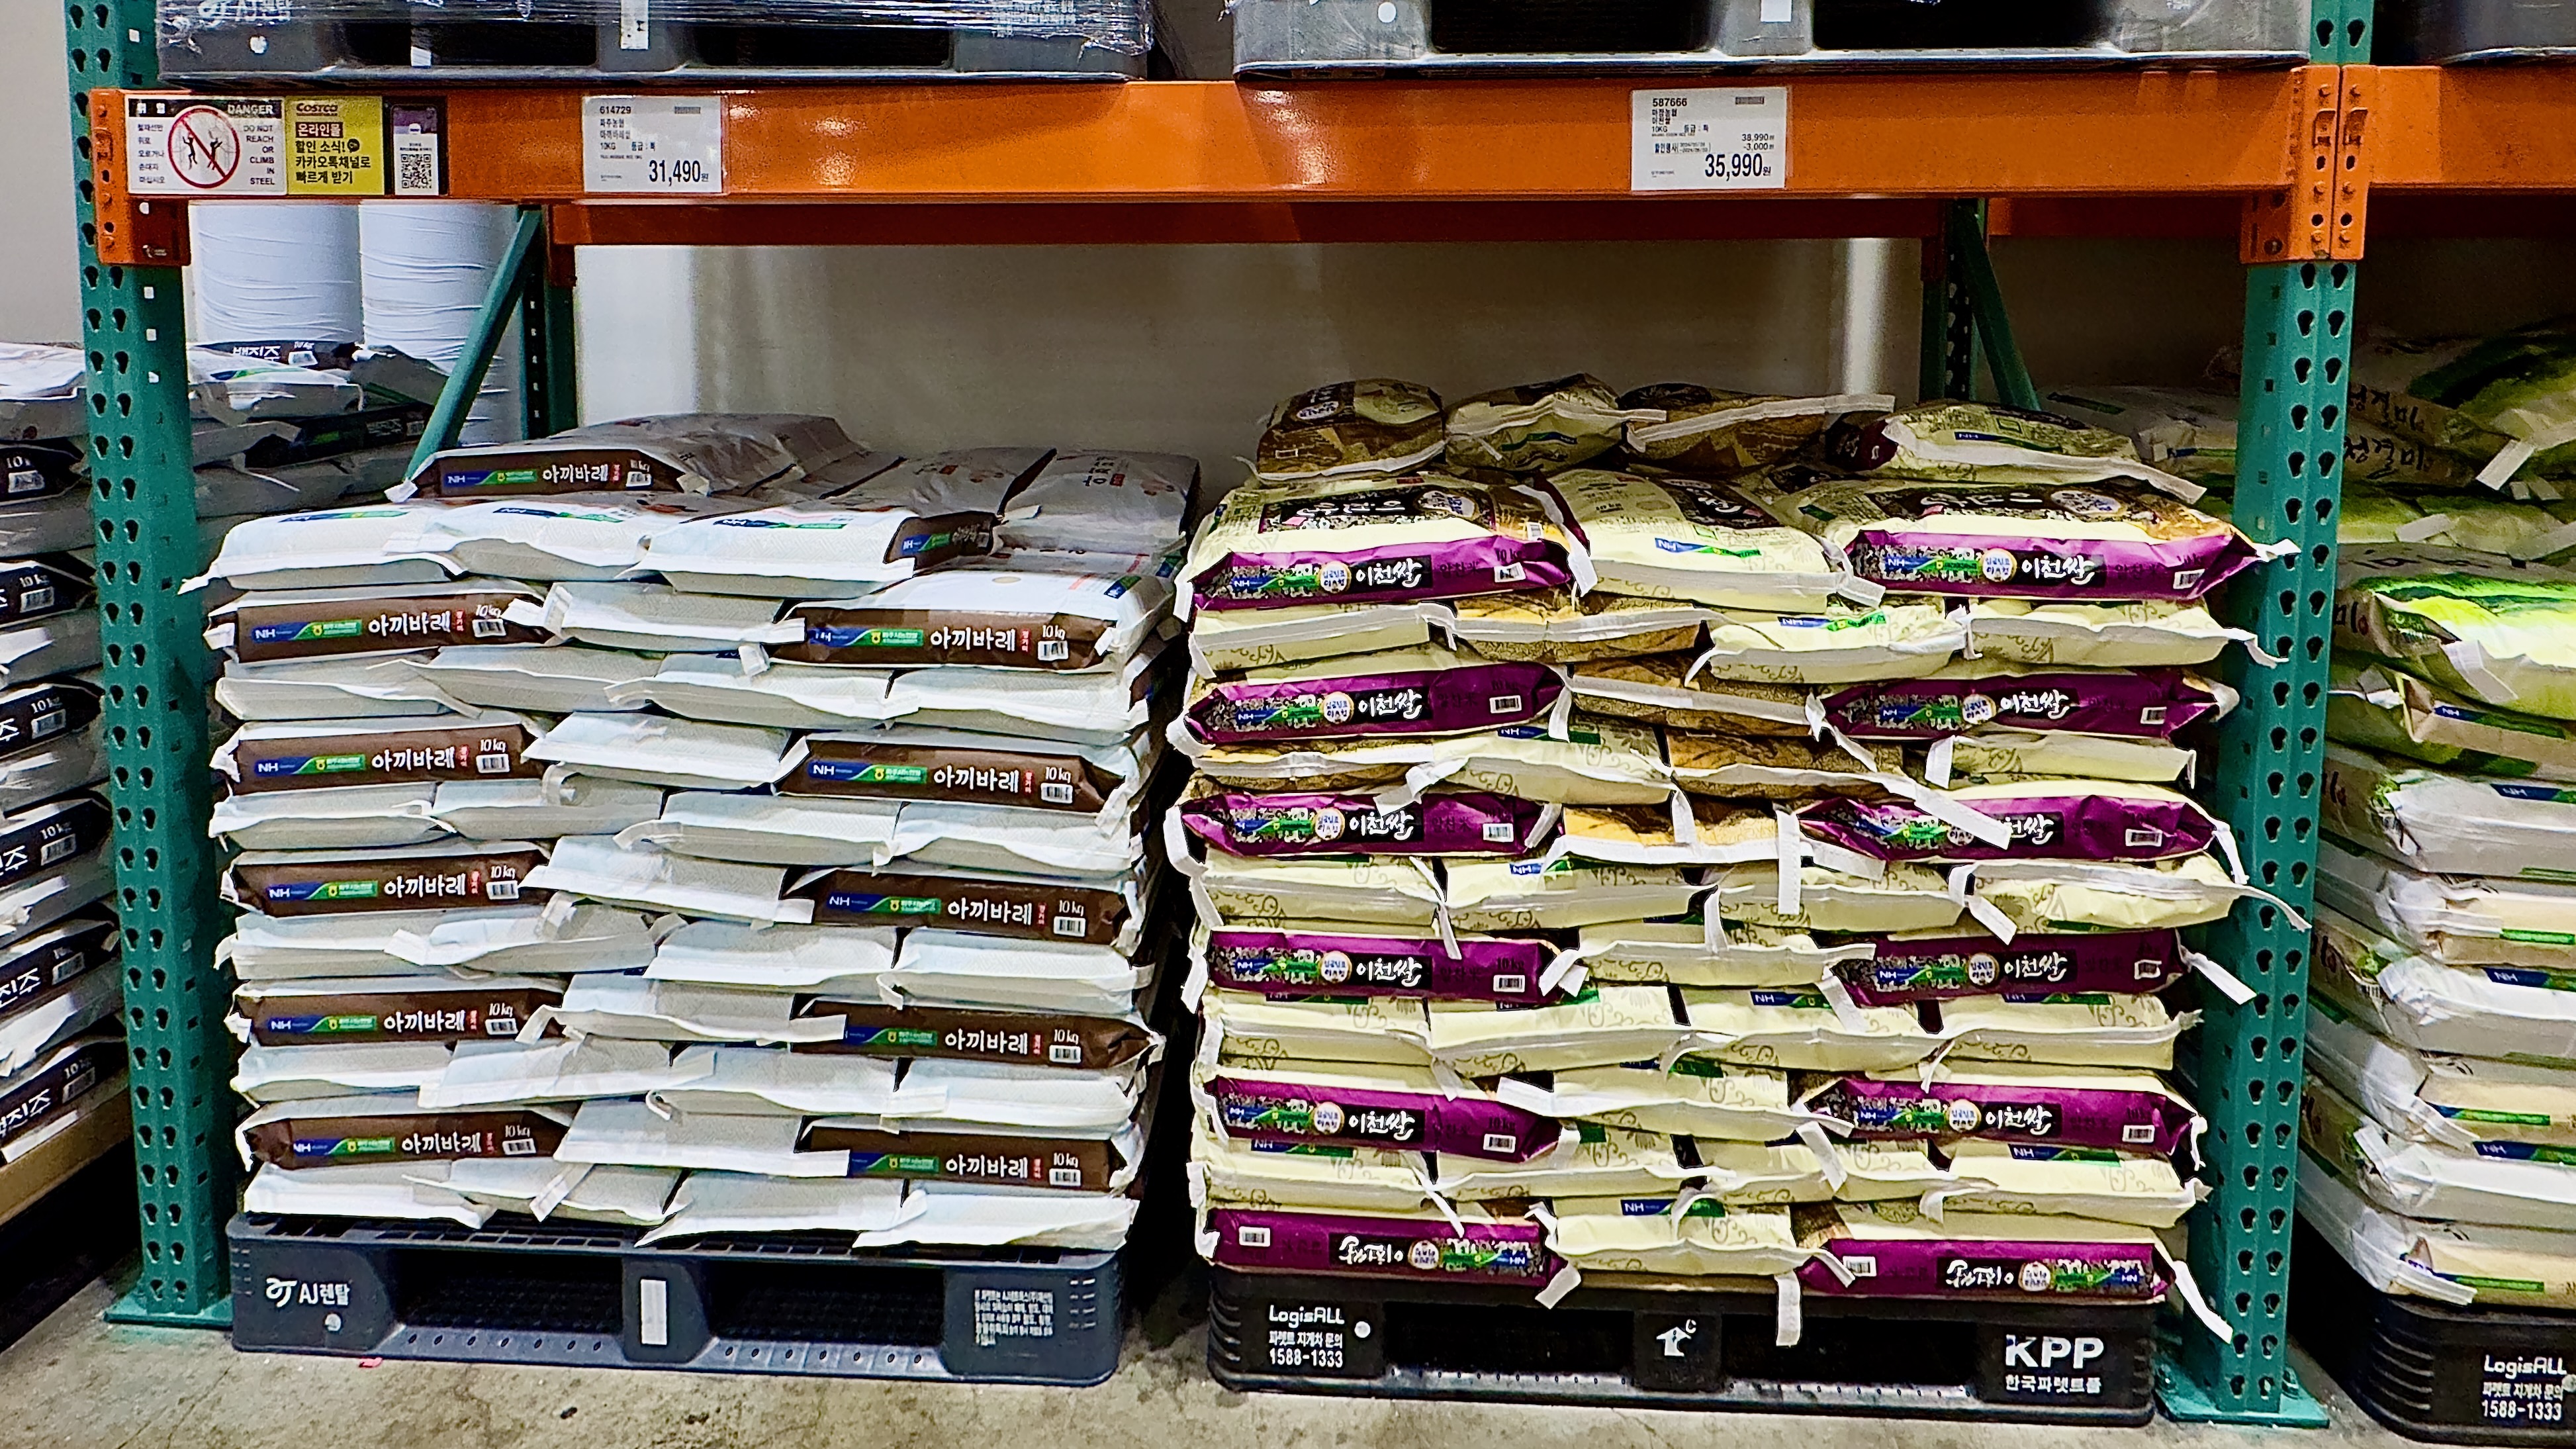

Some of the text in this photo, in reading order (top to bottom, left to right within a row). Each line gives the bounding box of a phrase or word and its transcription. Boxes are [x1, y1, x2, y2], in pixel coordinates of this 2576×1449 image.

[228, 105, 273, 115] DANGER
[1653, 98, 1687, 107] 587666
[298, 124, 341, 137] 온라인몰
[296, 140, 345, 154] 할인 소식!
[296, 156, 371, 169] 카카오톡채널로
[296, 171, 353, 183] 빠르게 받기
[543, 463, 608, 483] 아끼바레
[1658, 541, 1677, 551] NH
[1356, 558, 1422, 588] 이천쌀
[255, 628, 275, 639] NH
[369, 611, 451, 636] 아끼바레
[931, 626, 1015, 652] 아끼바레
[1358, 689, 1422, 720] 이천쌀
[2000, 690, 2070, 719] 이천쌀
[2442, 708, 2460, 716] NH
[258, 762, 278, 772] NH
[372, 747, 455, 771] 아끼바레
[813, 765, 835, 776] NH
[934, 765, 1019, 794] 아끼바레
[1350, 810, 1415, 840] 이천쌀
[2004, 814, 2054, 844] 천쌀
[1513, 865, 1532, 874] NH
[269, 888, 290, 898] NH
[384, 872, 465, 898] 아끼바레
[829, 896, 850, 906] NH
[948, 897, 1032, 925] 아끼바레
[1356, 957, 1422, 986] 이천쌀
[1880, 970, 1896, 980] NH
[2005, 952, 2068, 982] 이천쌀
[2495, 971, 2518, 982] NH
[1755, 994, 1775, 1004] NH
[271, 1019, 291, 1030] NH
[384, 1009, 465, 1033] 아끼바레
[945, 1029, 1029, 1054] 아끼바레
[1230, 1107, 1245, 1116] NH
[1986, 1105, 2052, 1135] 이천쌀
[1349, 1111, 1415, 1141] 이천쌀
[294, 1143, 310, 1153] NH
[401, 1132, 482, 1154] 아끼바레
[1254, 1139, 1273, 1149] NH
[2013, 1147, 2035, 1158] NH
[2483, 1144, 2507, 1154] NH
[946, 1154, 1028, 1178] 아끼바레
[1624, 1202, 1644, 1213] NH
[299, 1283, 350, 1306] AJ렌탈
[1269, 1305, 1345, 1328] LogisALL
[1297, 1332, 1323, 1348] 지게차
[1325, 1332, 1342, 1348] 문의
[1269, 1348, 1343, 1368] 1588-1333
[2005, 1334, 2104, 1370] KPP
[2484, 1354, 2567, 1379] LogisALL
[2005, 1374, 2101, 1394] 한국파렛트풀
[2482, 1399, 2561, 1421] 1588-1333
